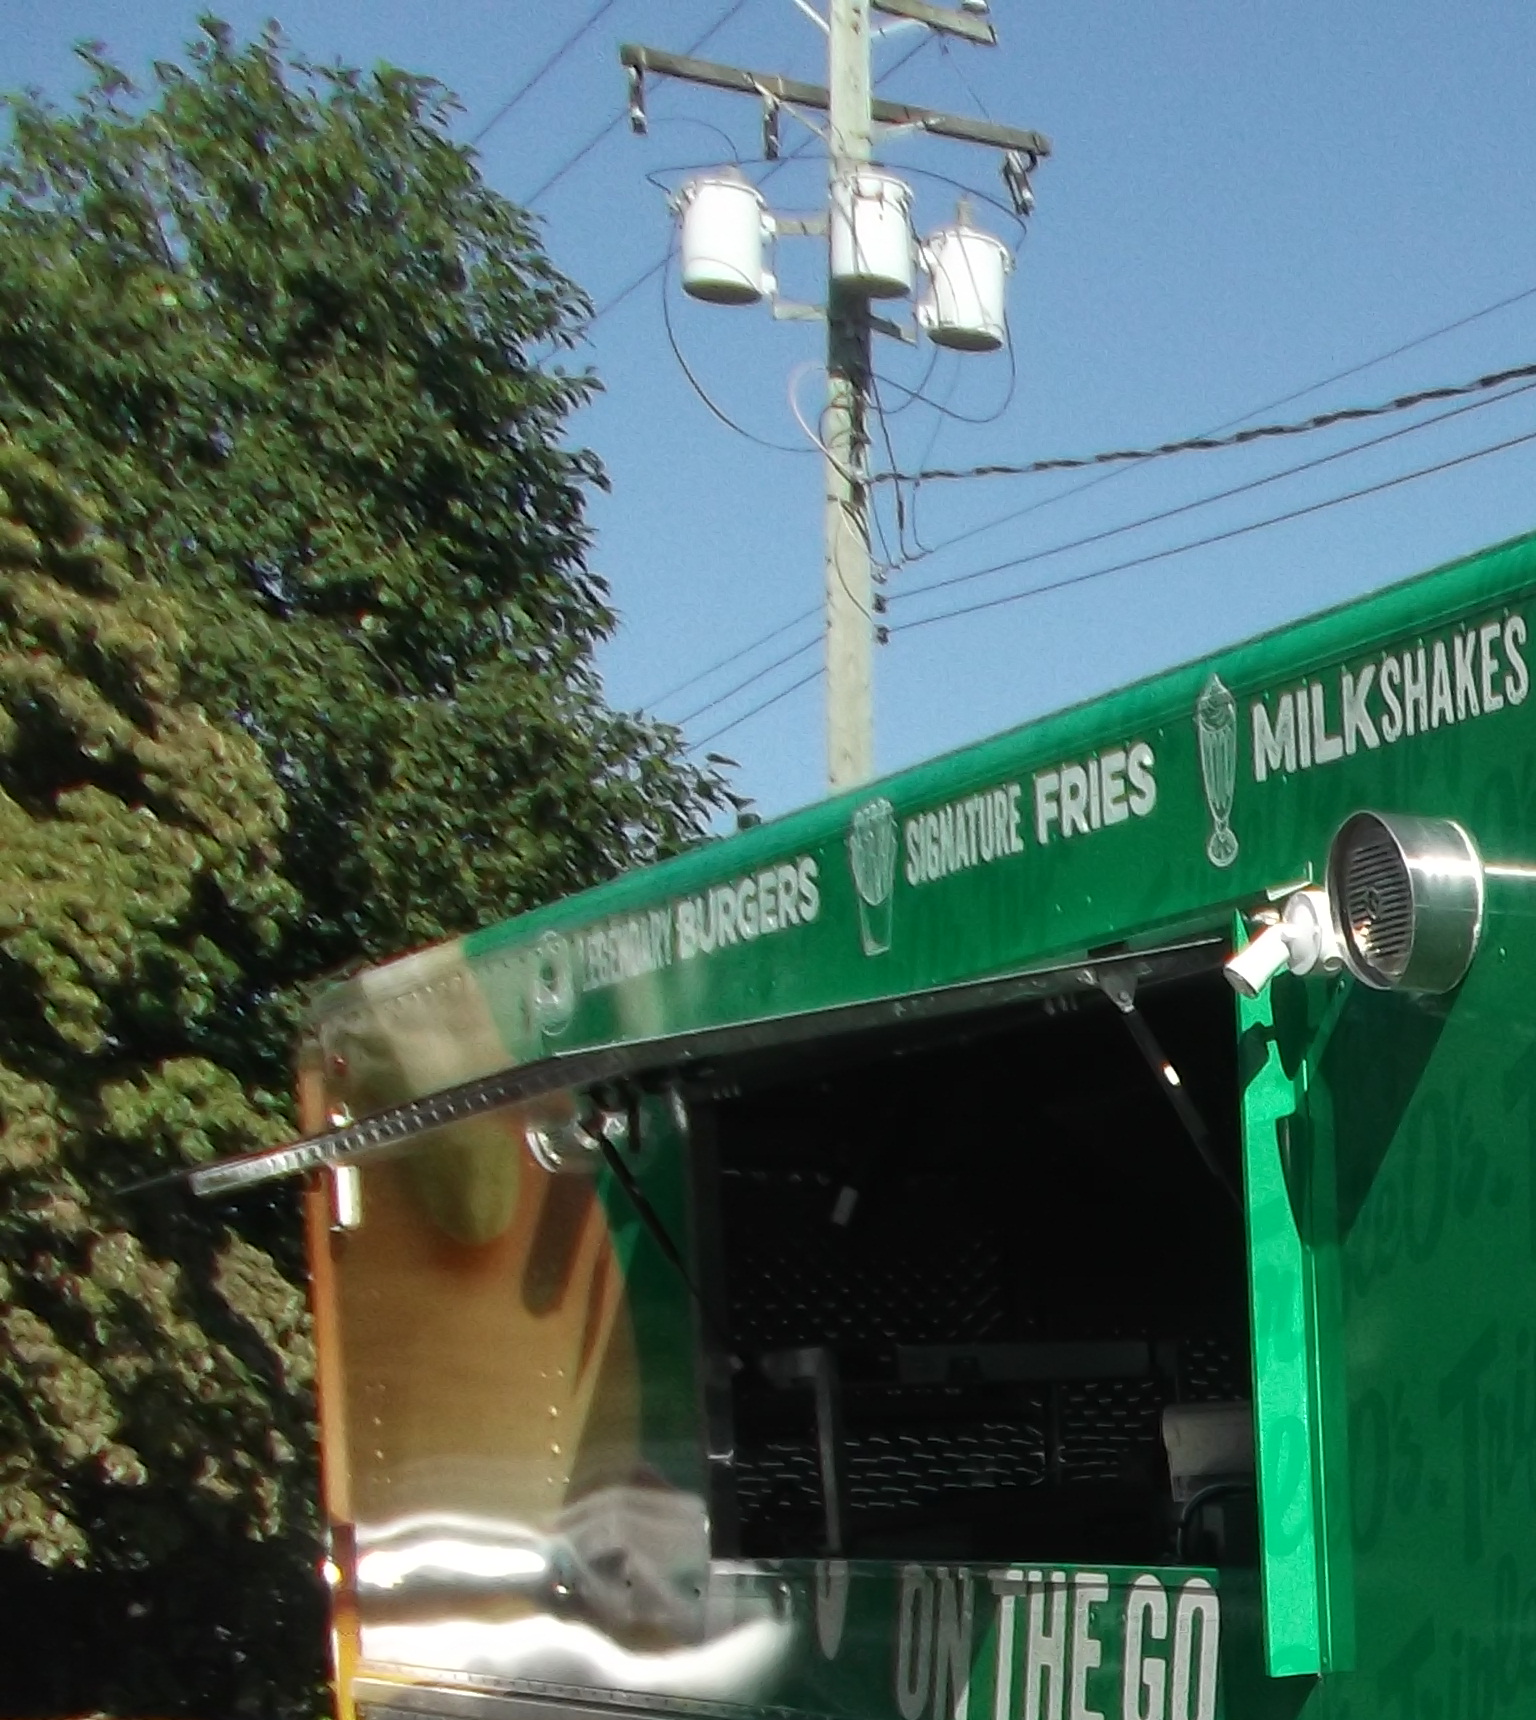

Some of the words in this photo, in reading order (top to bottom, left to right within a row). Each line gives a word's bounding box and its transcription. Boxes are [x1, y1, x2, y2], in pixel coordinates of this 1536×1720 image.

[1252, 614, 1528, 782] MILKSHAKES
[905, 783, 1024, 887] SIGNATURE
[1035, 741, 1157, 845] FRIES
[677, 856, 820, 960] BURGERS
